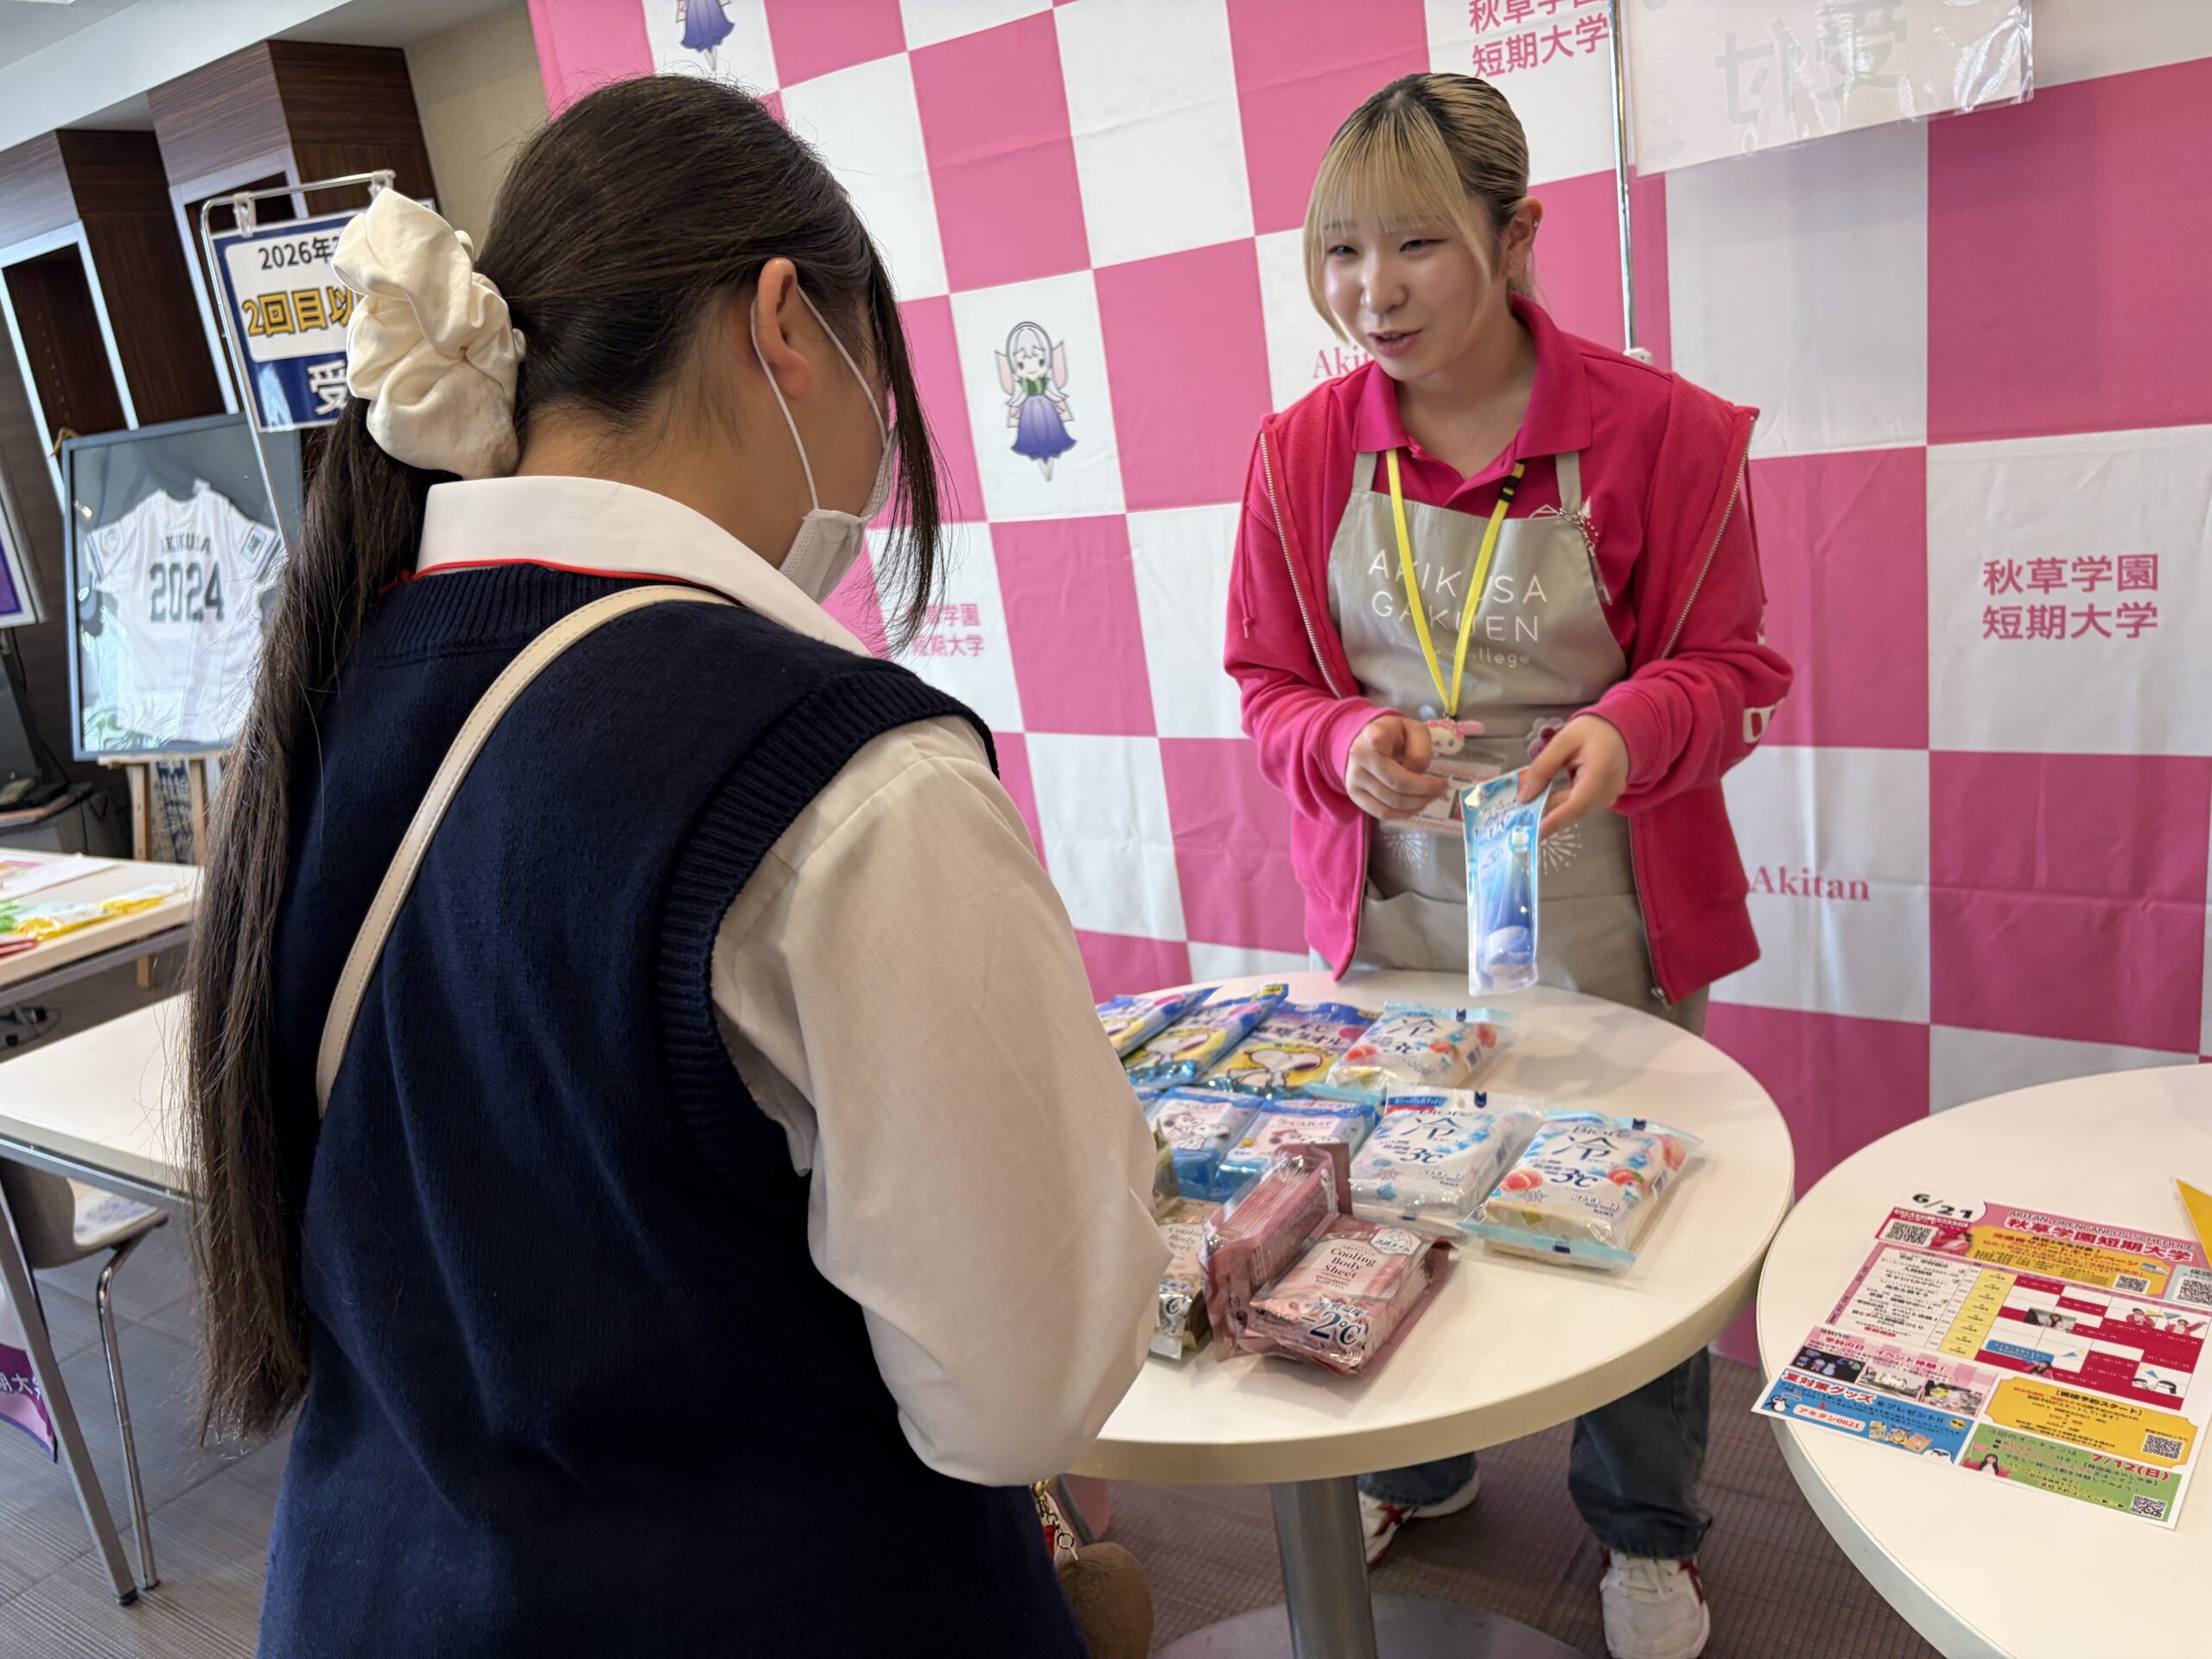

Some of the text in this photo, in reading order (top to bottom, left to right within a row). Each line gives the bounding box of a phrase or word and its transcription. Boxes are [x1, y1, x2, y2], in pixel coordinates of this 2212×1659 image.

[1469, 0, 1607, 35] 秋草
[1471, 12, 1609, 79] 短期大学
[258, 236, 340, 270] 2026年
[242, 286, 366, 338] 2回目以
[149, 562, 225, 622] 2024
[1983, 554, 2158, 595] 秋草学園
[1983, 601, 2158, 639] 短期大学
[1749, 865, 1870, 901] Akitan
[1912, 1193, 1974, 1219] 6/21
[2006, 1218, 2191, 1260] 秋草学園短期大学
[1324, 1264, 1357, 1279] Sheet
[1331, 1247, 1376, 1268] Cooling
[1331, 1256, 1362, 1273] Body
[1781, 1371, 1875, 1403] 夏対策グッズ
[1796, 1406, 1860, 1428] アキタン0621
